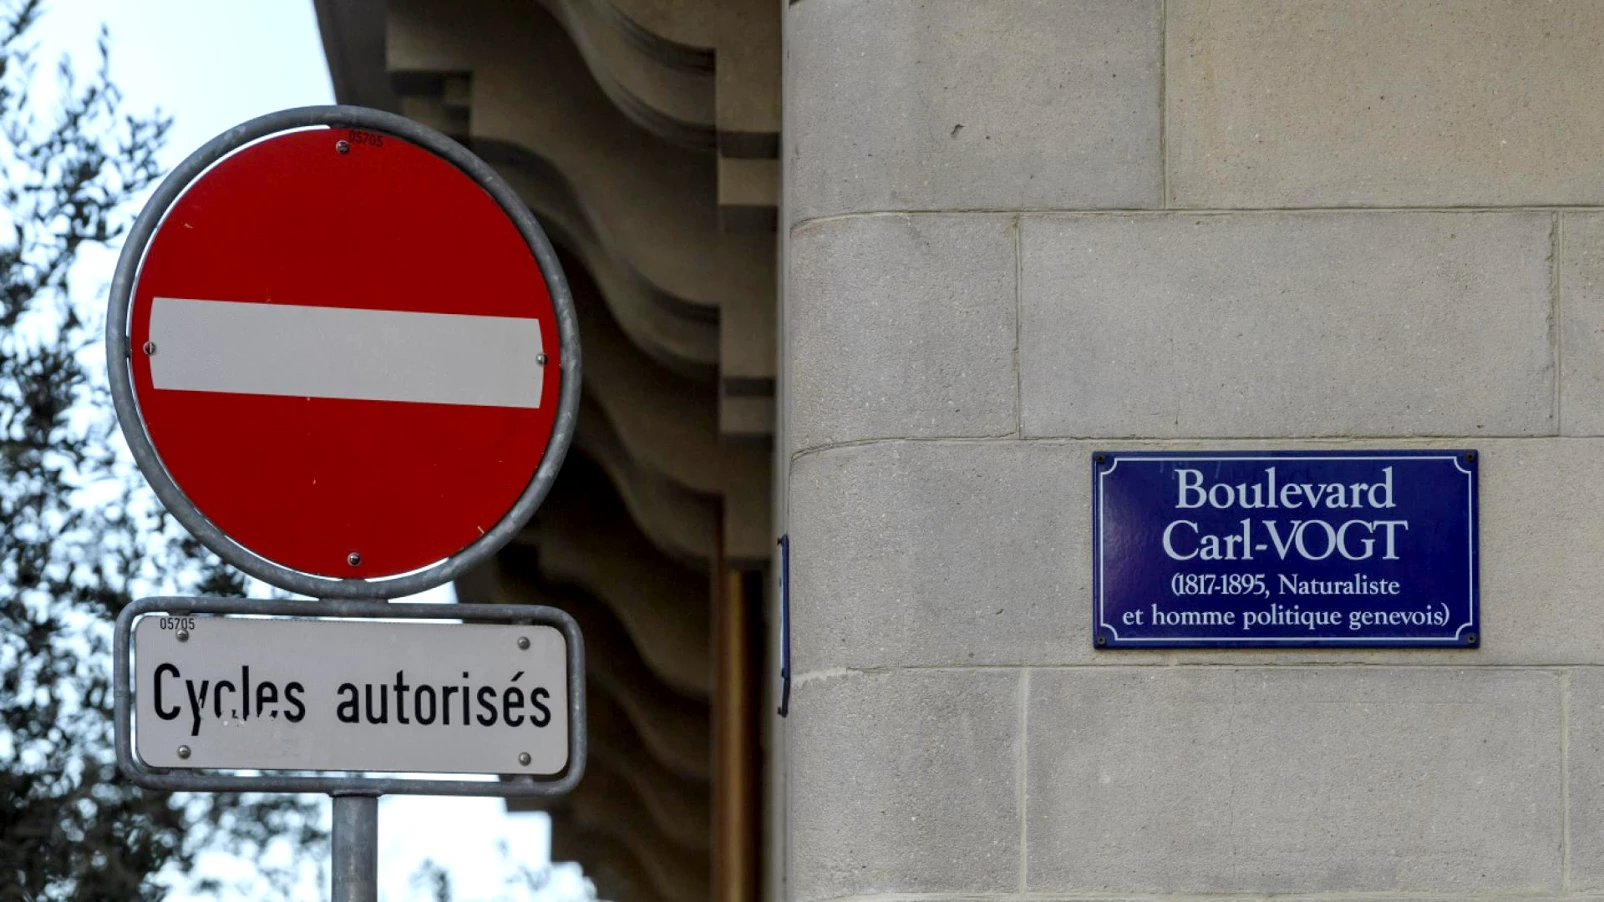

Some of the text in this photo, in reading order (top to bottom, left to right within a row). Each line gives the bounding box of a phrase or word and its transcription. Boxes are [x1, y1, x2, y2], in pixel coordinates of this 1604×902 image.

[348, 129, 384, 147] 05705
[1174, 466, 1396, 509] Boulevard
[1162, 518, 1409, 561] Carl-VOGT
[1171, 573, 1400, 599] (1817-1895, Naturaliste
[159, 617, 195, 630] 05705
[1122, 602, 1450, 631] et homme politique genevois)
[154, 662, 552, 736] Cycles autorisés
